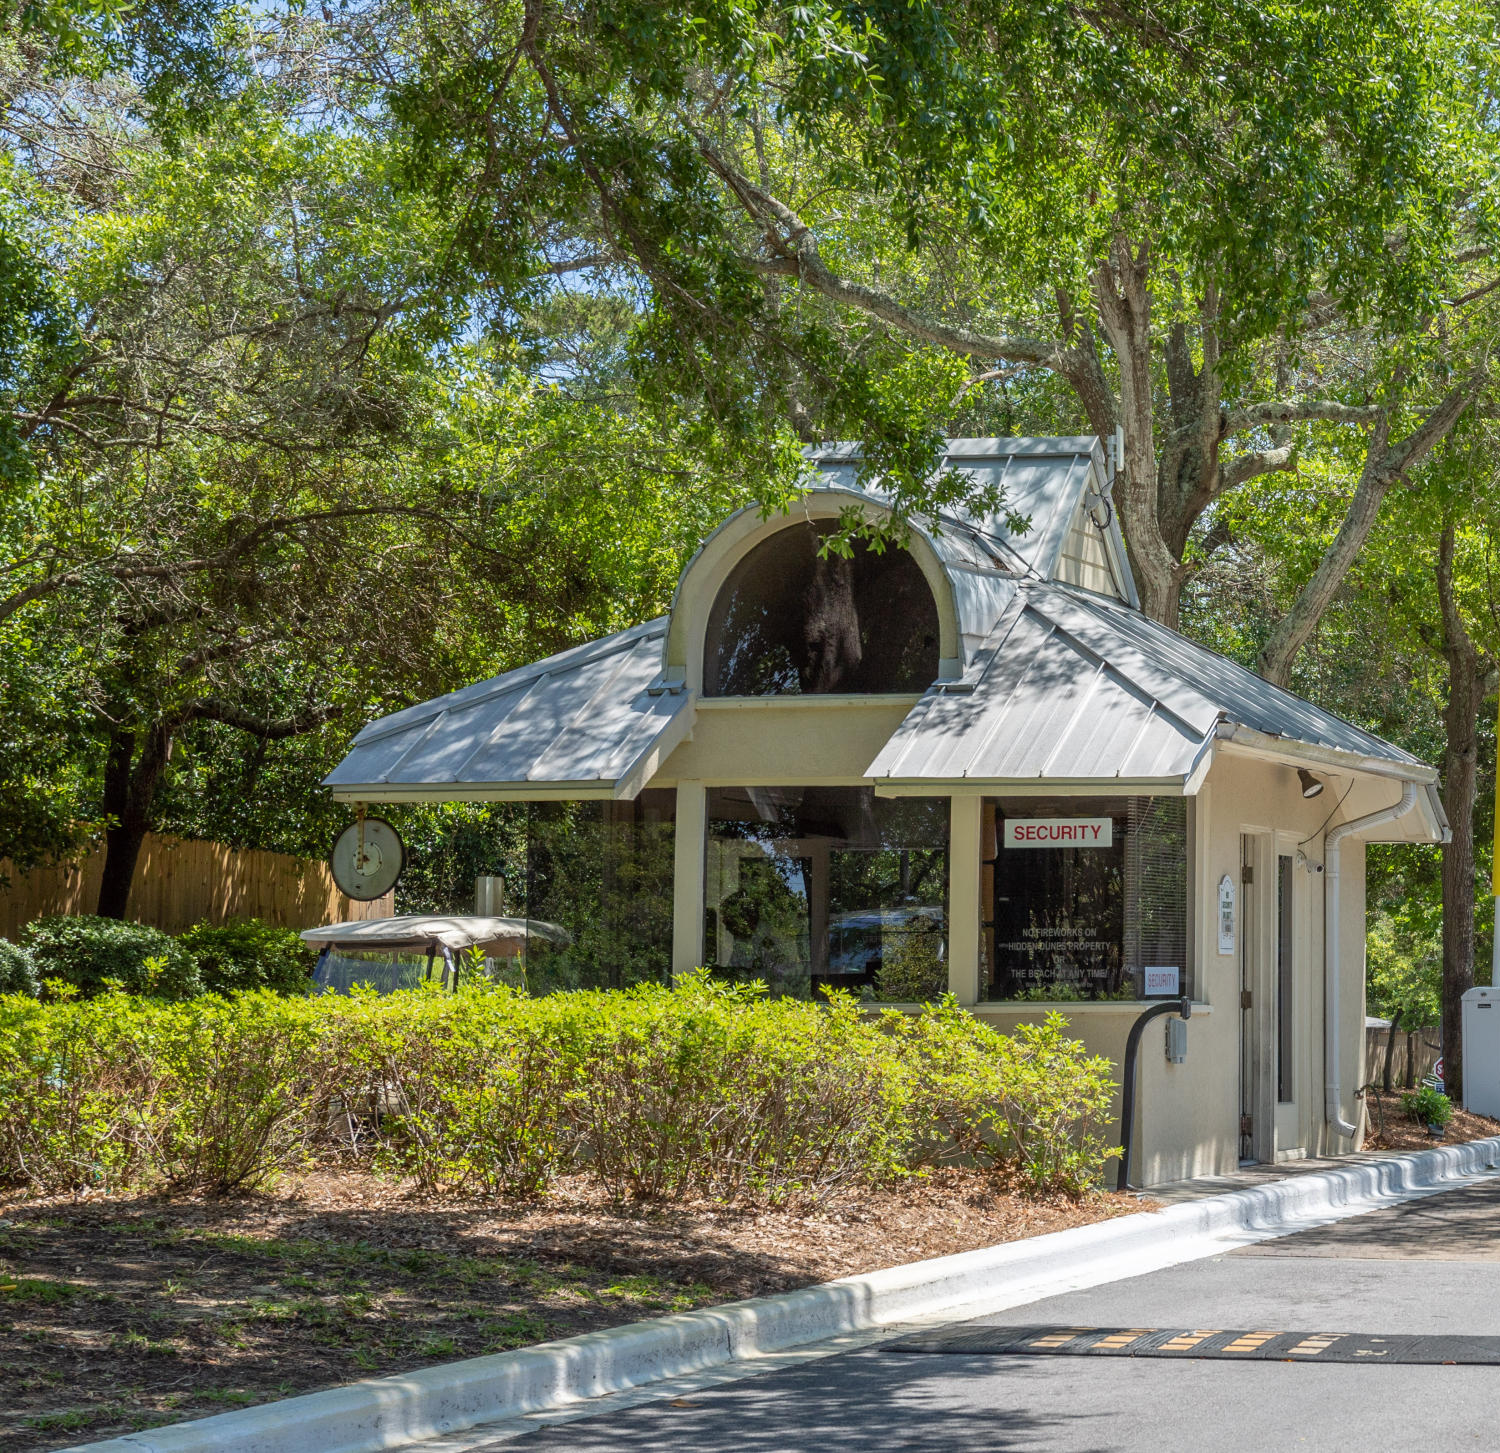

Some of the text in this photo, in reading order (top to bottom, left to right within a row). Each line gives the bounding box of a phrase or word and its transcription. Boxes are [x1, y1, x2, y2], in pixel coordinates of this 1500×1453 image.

[1014, 825, 1101, 840] SECURITY
[1022, 928, 1097, 937] NO FIREWORKS ON
[1041, 942, 1066, 951] DUNES
[1069, 942, 1111, 951] PROPERTY
[1053, 956, 1065, 964] OR
[1011, 969, 1025, 978] THE
[1028, 969, 1055, 978] BEACH
[1069, 969, 1085, 978] ANY
[1148, 973, 1176, 987] SECURITY
